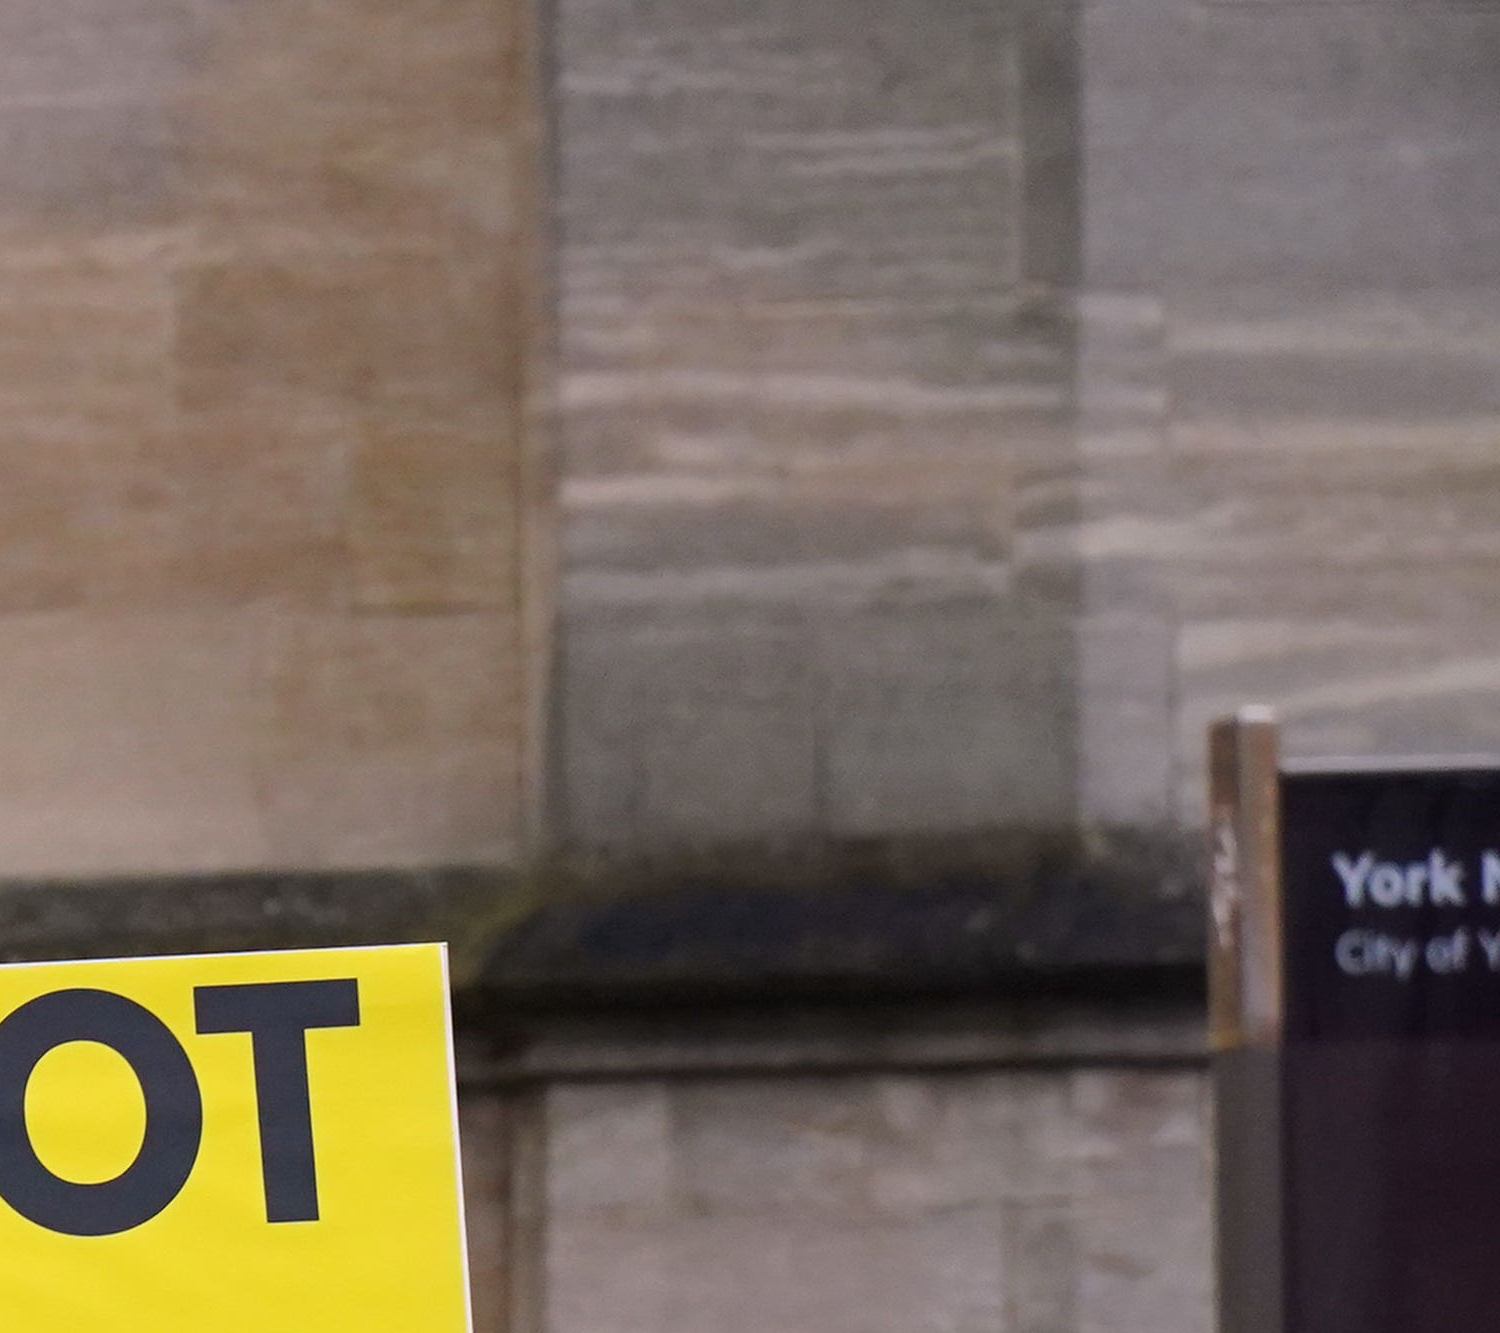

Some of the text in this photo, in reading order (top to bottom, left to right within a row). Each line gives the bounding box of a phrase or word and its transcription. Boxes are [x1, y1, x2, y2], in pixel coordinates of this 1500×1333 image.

[1332, 849, 1464, 906] York
[1334, 929, 1417, 982] City
[1425, 927, 1470, 976] of
